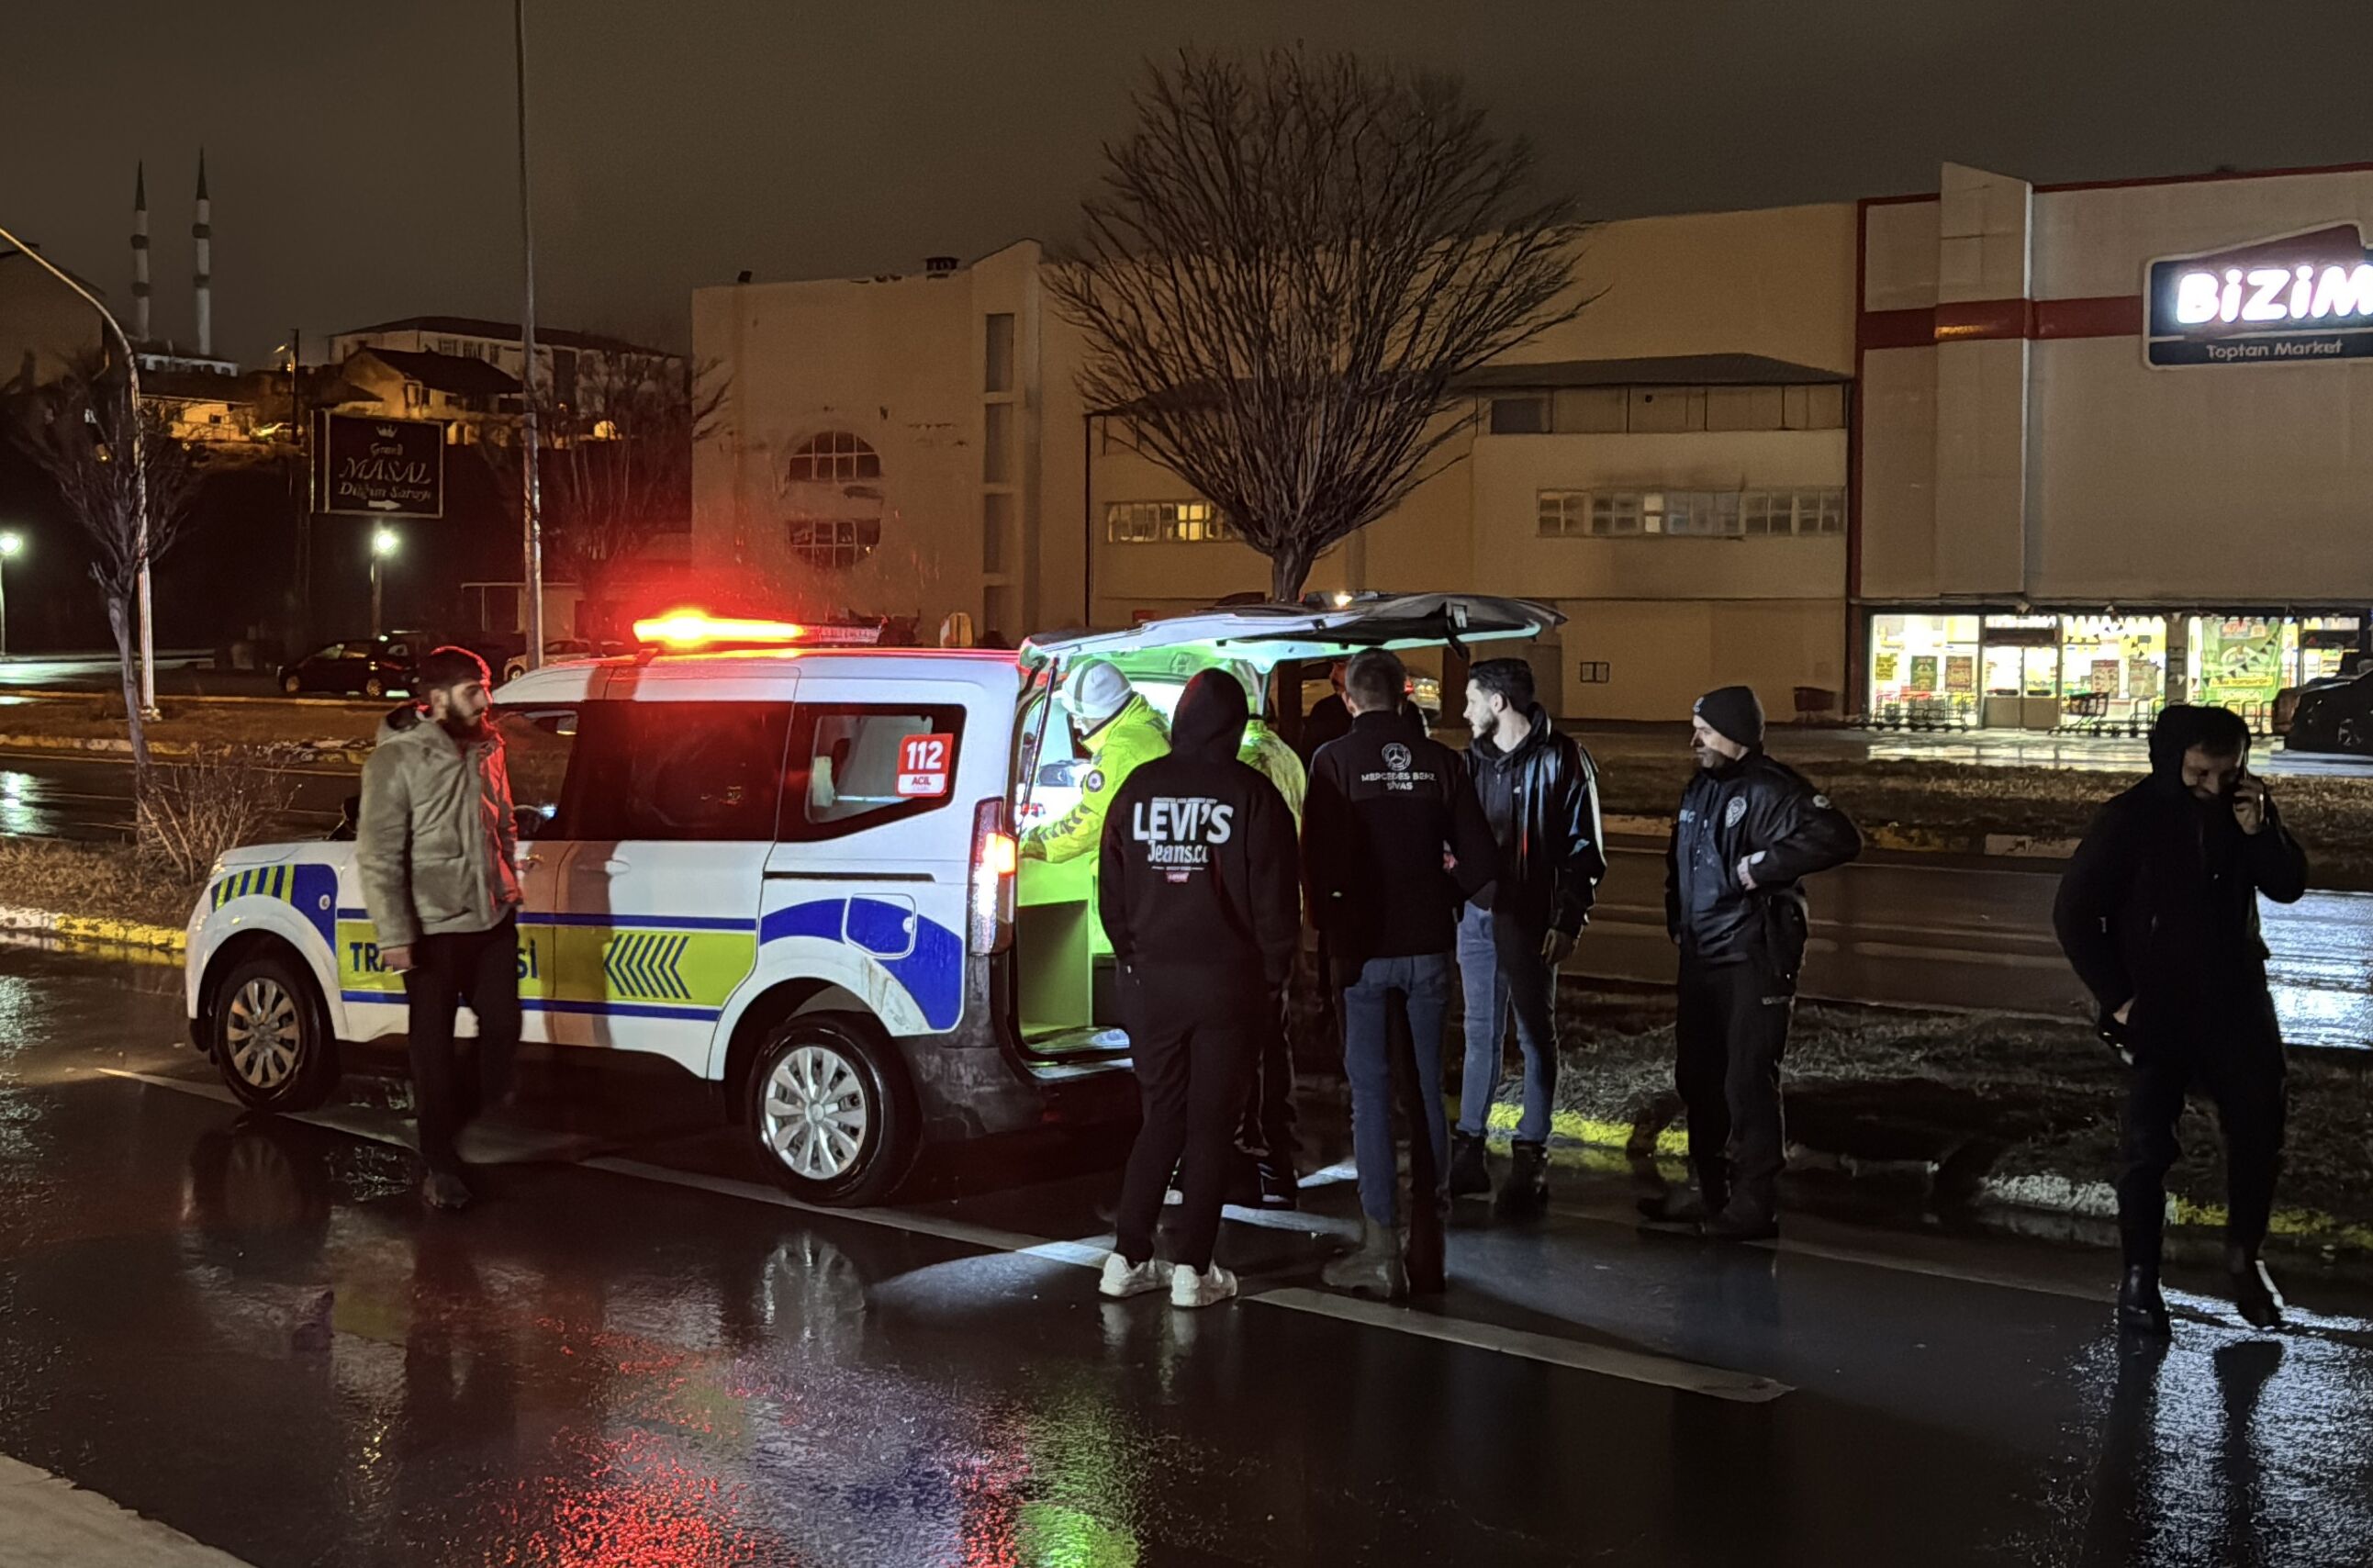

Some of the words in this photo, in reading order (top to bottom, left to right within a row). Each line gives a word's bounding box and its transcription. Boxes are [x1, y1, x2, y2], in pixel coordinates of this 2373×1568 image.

[2206, 342, 2269, 361] Toptan
[2274, 340, 2343, 356] Market
[339, 457, 432, 485] MASAL
[907, 740, 944, 770] 112
[1360, 771, 1411, 782] MERCEDES
[1133, 801, 1234, 844] LEVI'S
